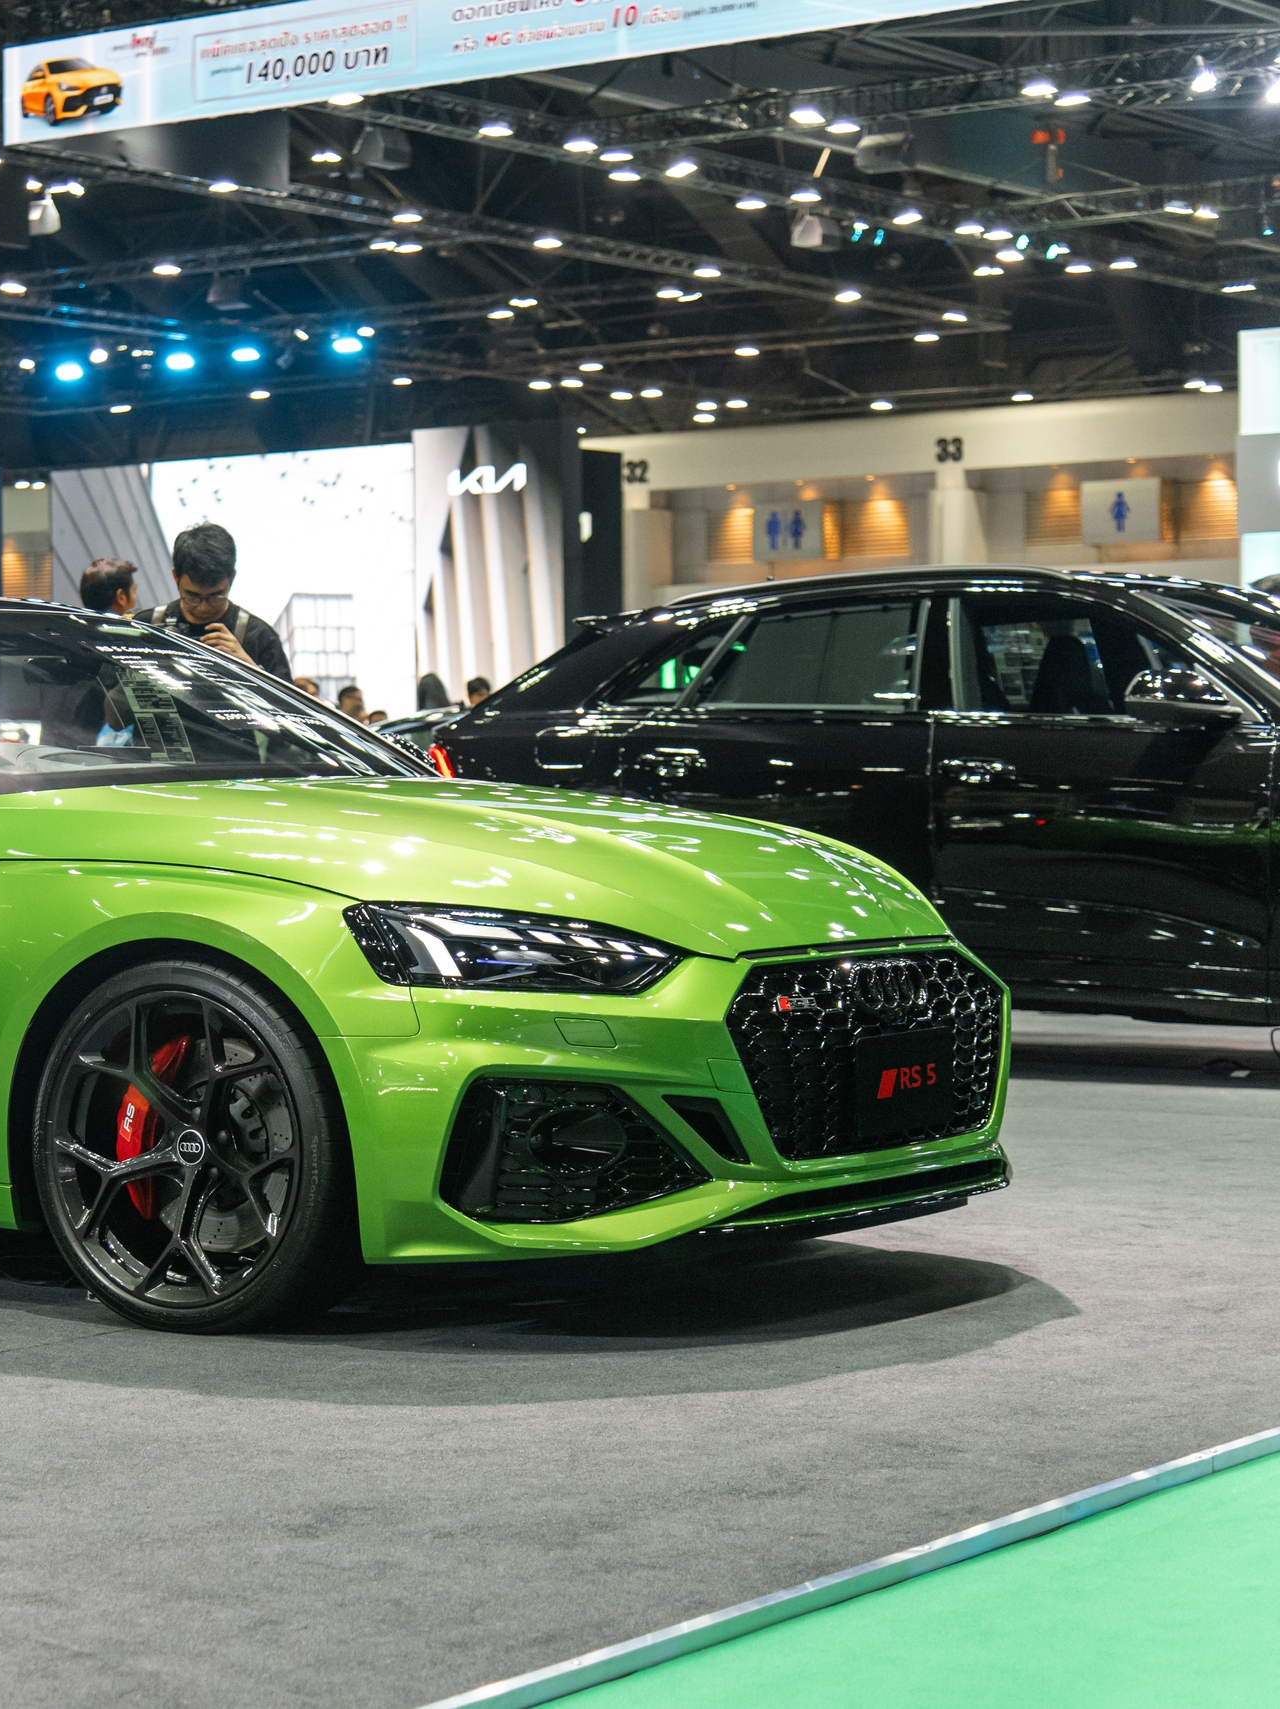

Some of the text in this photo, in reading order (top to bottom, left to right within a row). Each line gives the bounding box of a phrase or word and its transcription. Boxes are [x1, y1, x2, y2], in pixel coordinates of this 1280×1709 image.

[484, 31, 512, 48] MG
[612, 5, 638, 29] 10
[245, 46, 391, 87] 140,000 บาท
[936, 437, 963, 462] 33
[447, 462, 527, 496] KIA
[626, 460, 649, 483] 32
[900, 1063, 937, 1089] RS 5
[123, 1102, 136, 1133] RS
